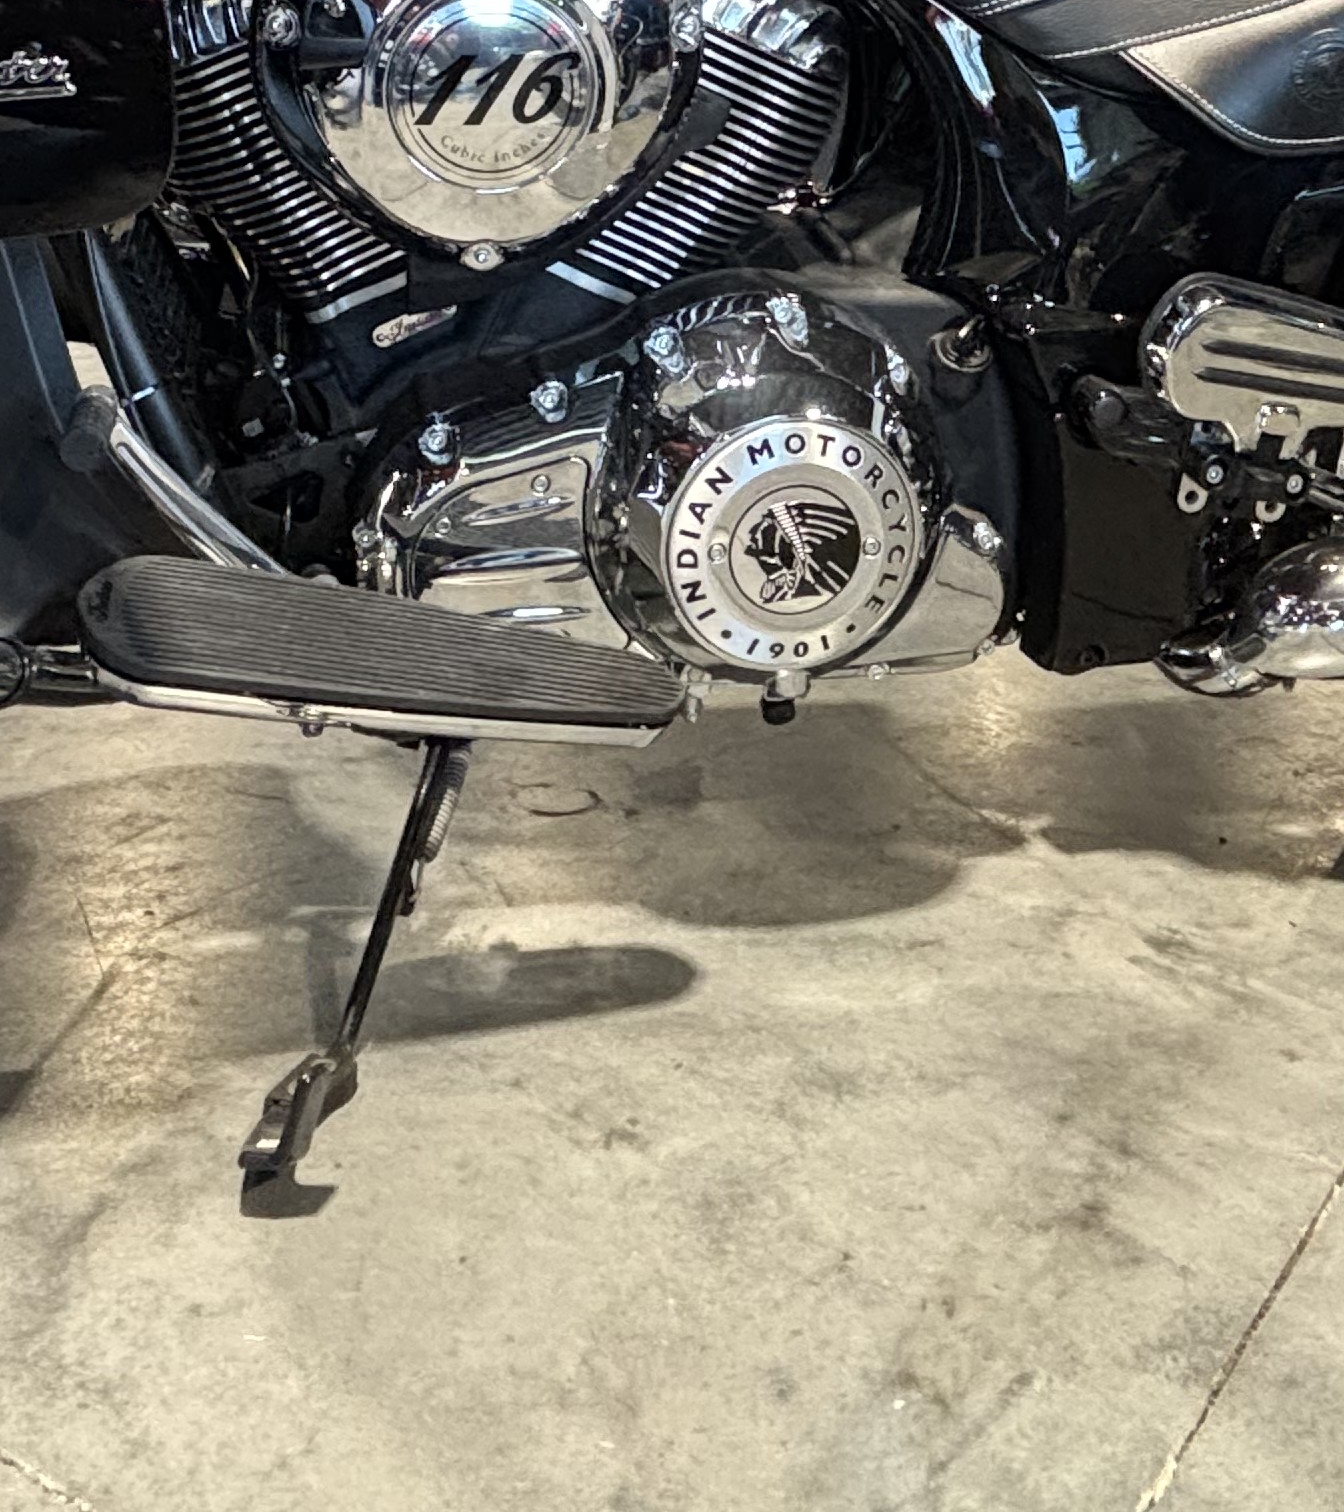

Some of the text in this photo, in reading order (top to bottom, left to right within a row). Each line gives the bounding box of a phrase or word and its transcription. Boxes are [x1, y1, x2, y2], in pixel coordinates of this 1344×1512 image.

[413, 52, 581, 125] 116
[676, 433, 906, 621] INDIAN MOTORCYCLE
[746, 635, 830, 658] 1901
